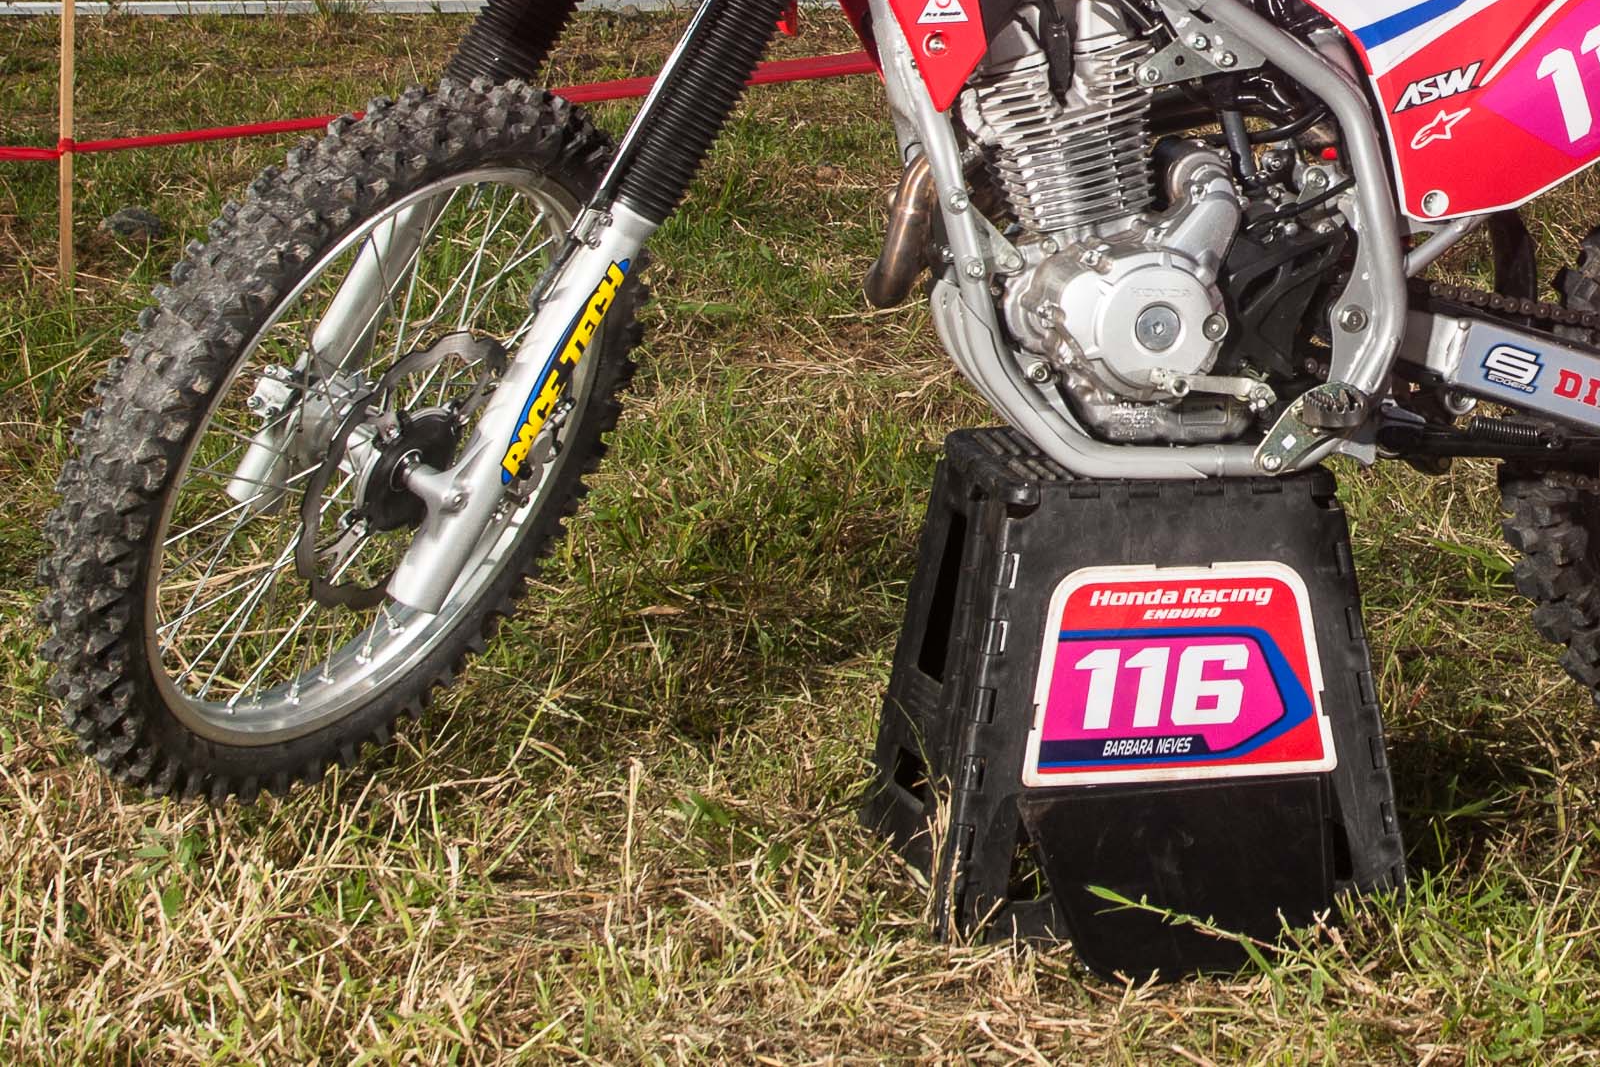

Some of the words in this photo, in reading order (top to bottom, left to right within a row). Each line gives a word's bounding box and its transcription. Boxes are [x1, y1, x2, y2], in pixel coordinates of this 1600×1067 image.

[1392, 59, 1485, 114] ASW
[501, 368, 567, 477] RACE
[559, 262, 625, 366] TECH
[1089, 588, 1179, 607] Honda
[1182, 587, 1273, 605] Racing
[1143, 607, 1222, 620] ENDURO
[1074, 643, 1250, 730] 116
[1102, 740, 1154, 757] BARBARA
[1155, 737, 1193, 754] NEVES
